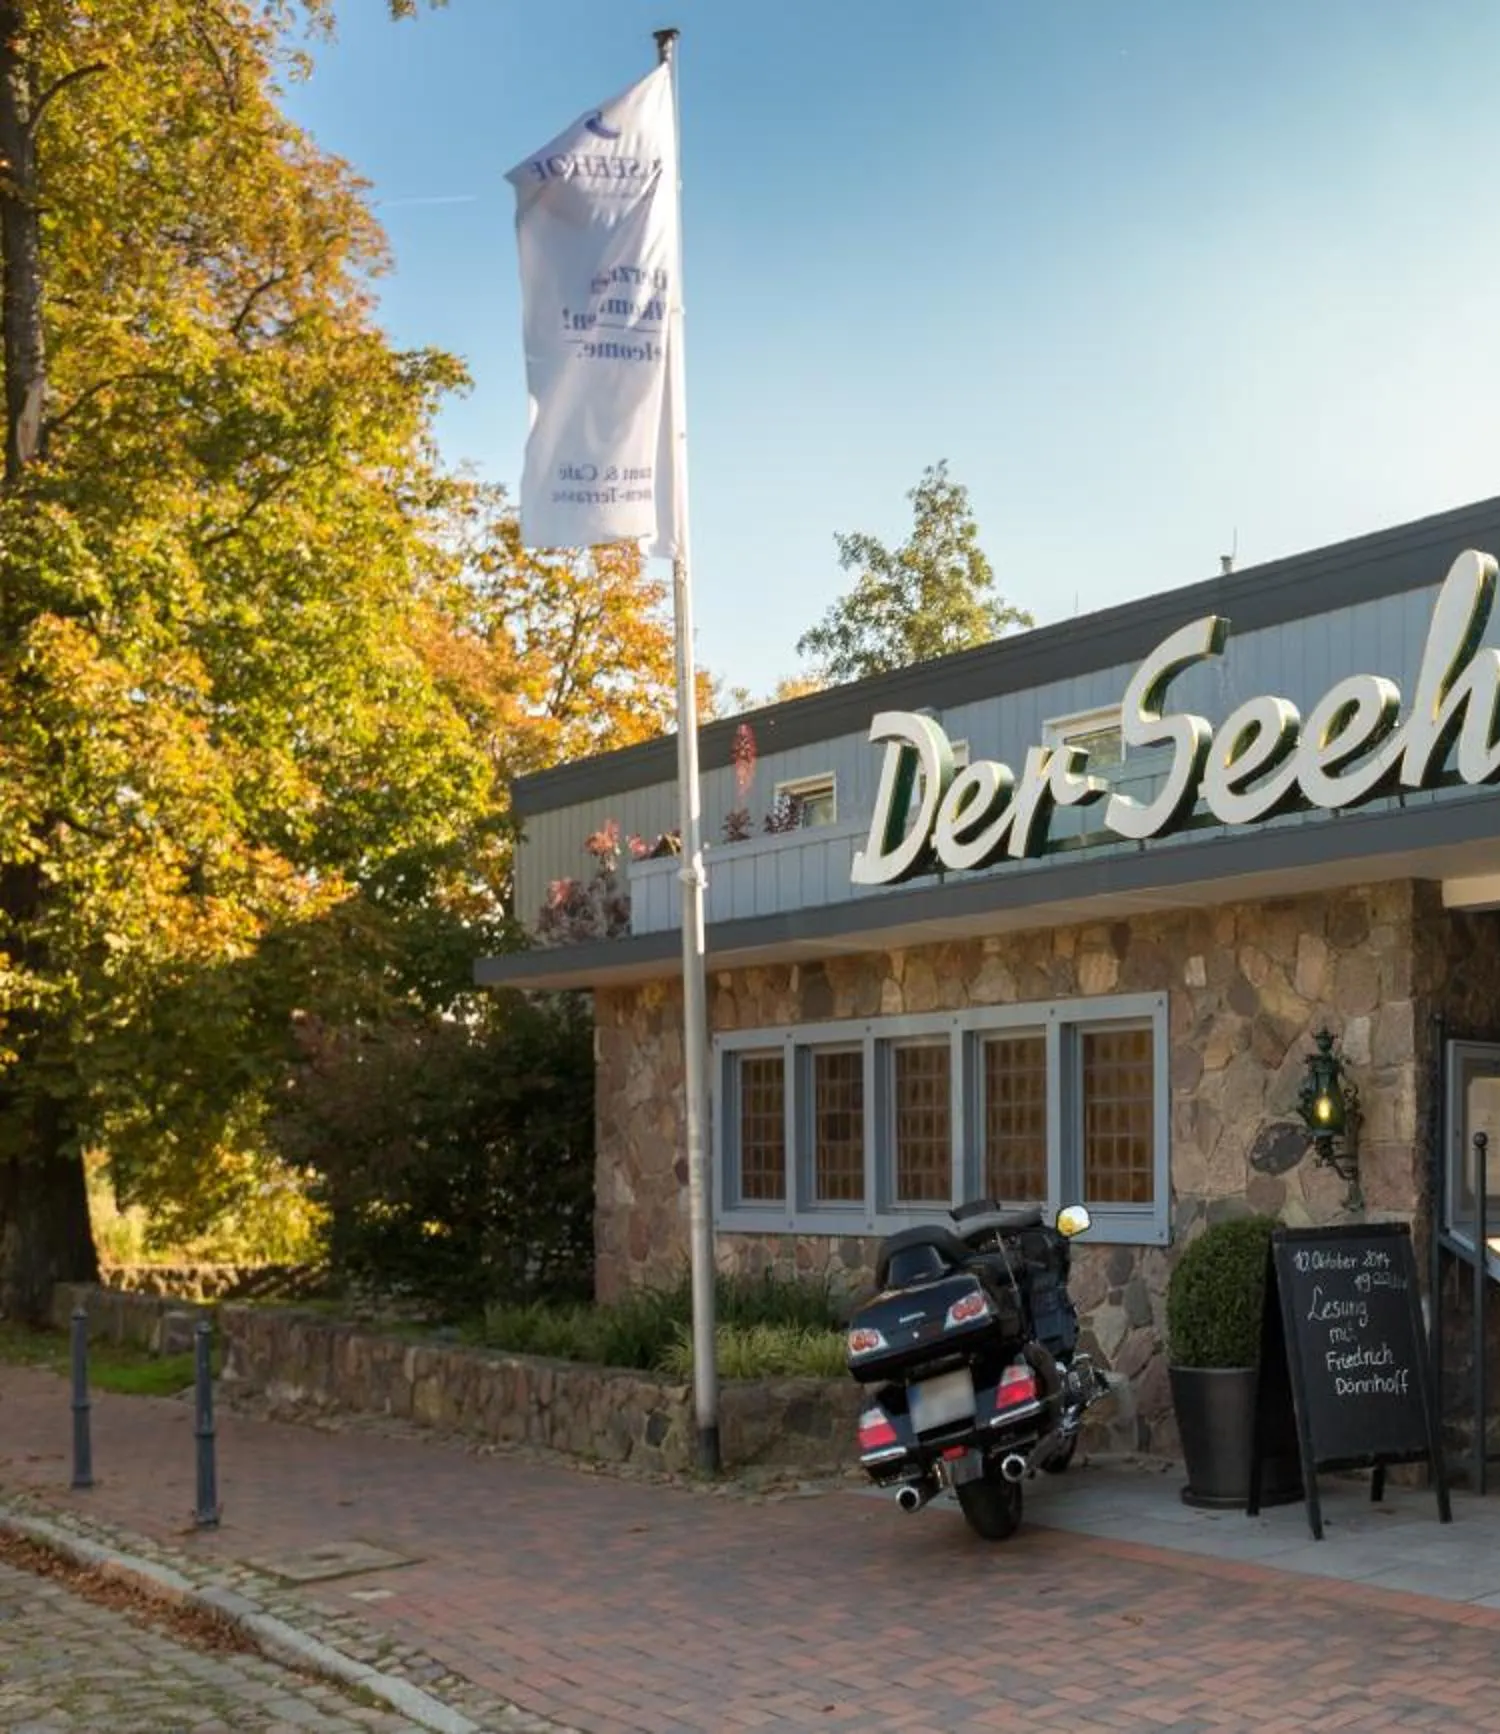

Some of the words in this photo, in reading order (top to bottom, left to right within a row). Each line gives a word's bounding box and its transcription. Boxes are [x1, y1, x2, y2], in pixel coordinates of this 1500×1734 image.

[851, 710, 1112, 886] Der
[1306, 1284, 1369, 1329] Lesung
[1325, 1342, 1394, 1372] Friedrich
